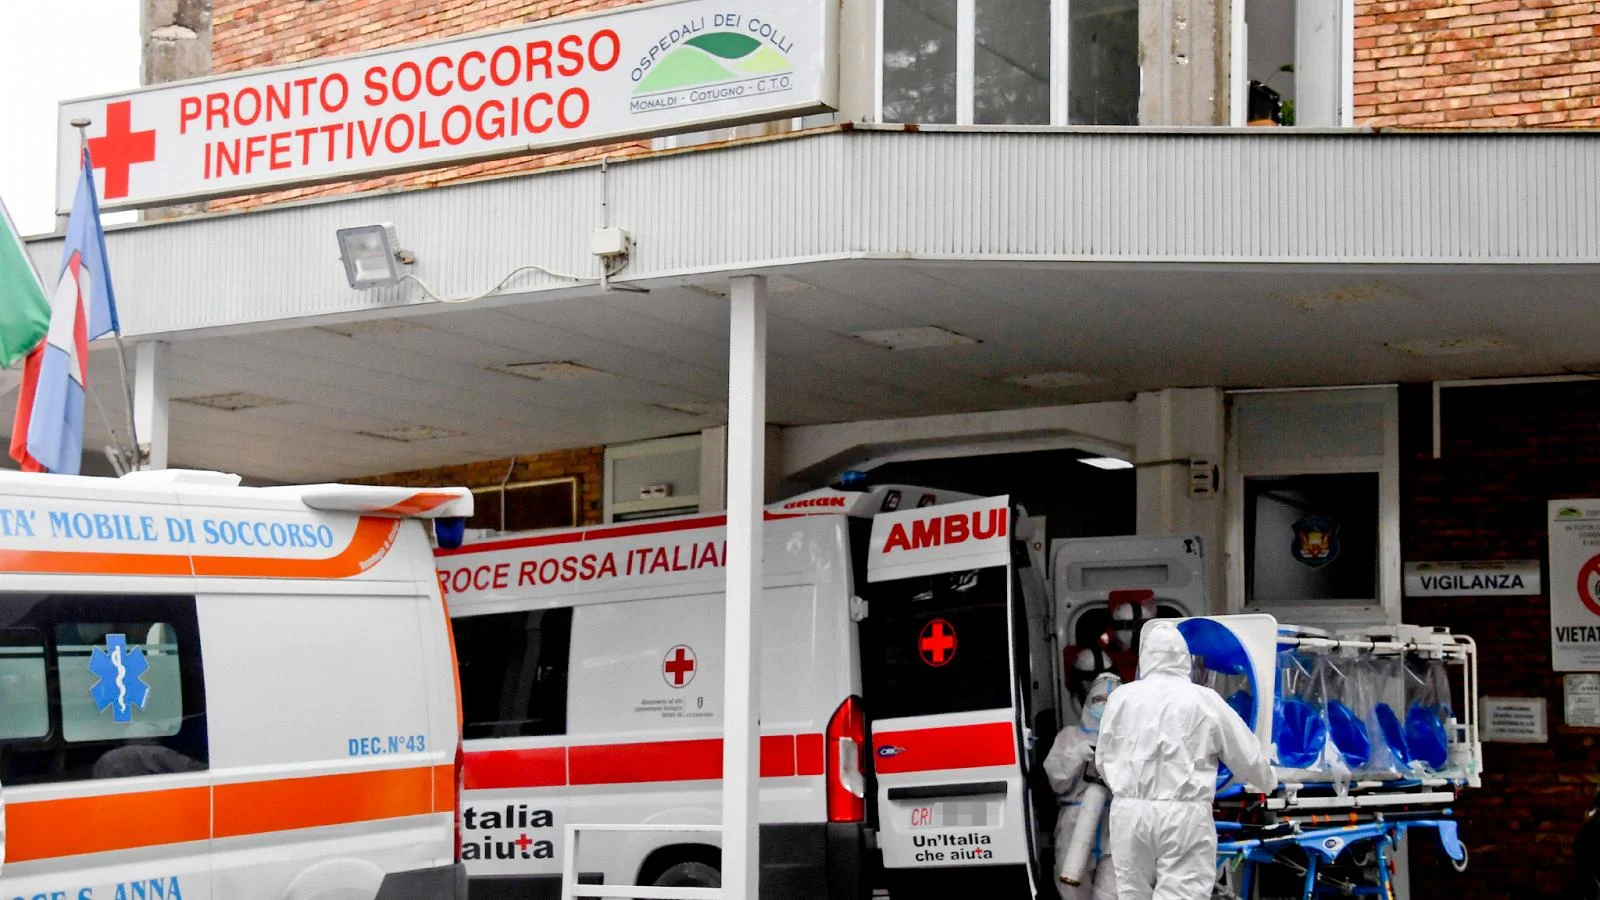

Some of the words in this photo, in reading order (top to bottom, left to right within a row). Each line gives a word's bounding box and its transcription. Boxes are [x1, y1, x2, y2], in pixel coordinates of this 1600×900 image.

[631, 17, 705, 82] OSPEDALI
[714, 13, 741, 28] DEI
[748, 18, 793, 54] COLLI
[180, 73, 349, 135] PRONTO
[364, 28, 621, 106] SOCCORSO
[630, 96, 677, 111] MONALDI
[690, 86, 744, 102] COTUGNO
[204, 87, 590, 180] INFETTIVOLOGICO
[48, 511, 158, 542] MOBILE
[166, 517, 195, 544] DI
[203, 520, 334, 549] SOCCORSO
[518, 552, 617, 587] ROSSA
[626, 540, 727, 576] ITALIA
[1420, 574, 1524, 590] VIGILANZA
[911, 807, 932, 826] CRI
[462, 834, 554, 860] aiuta
[913, 833, 991, 847] Un'Italia
[915, 850, 944, 861] che
[951, 848, 993, 860] aiuta
